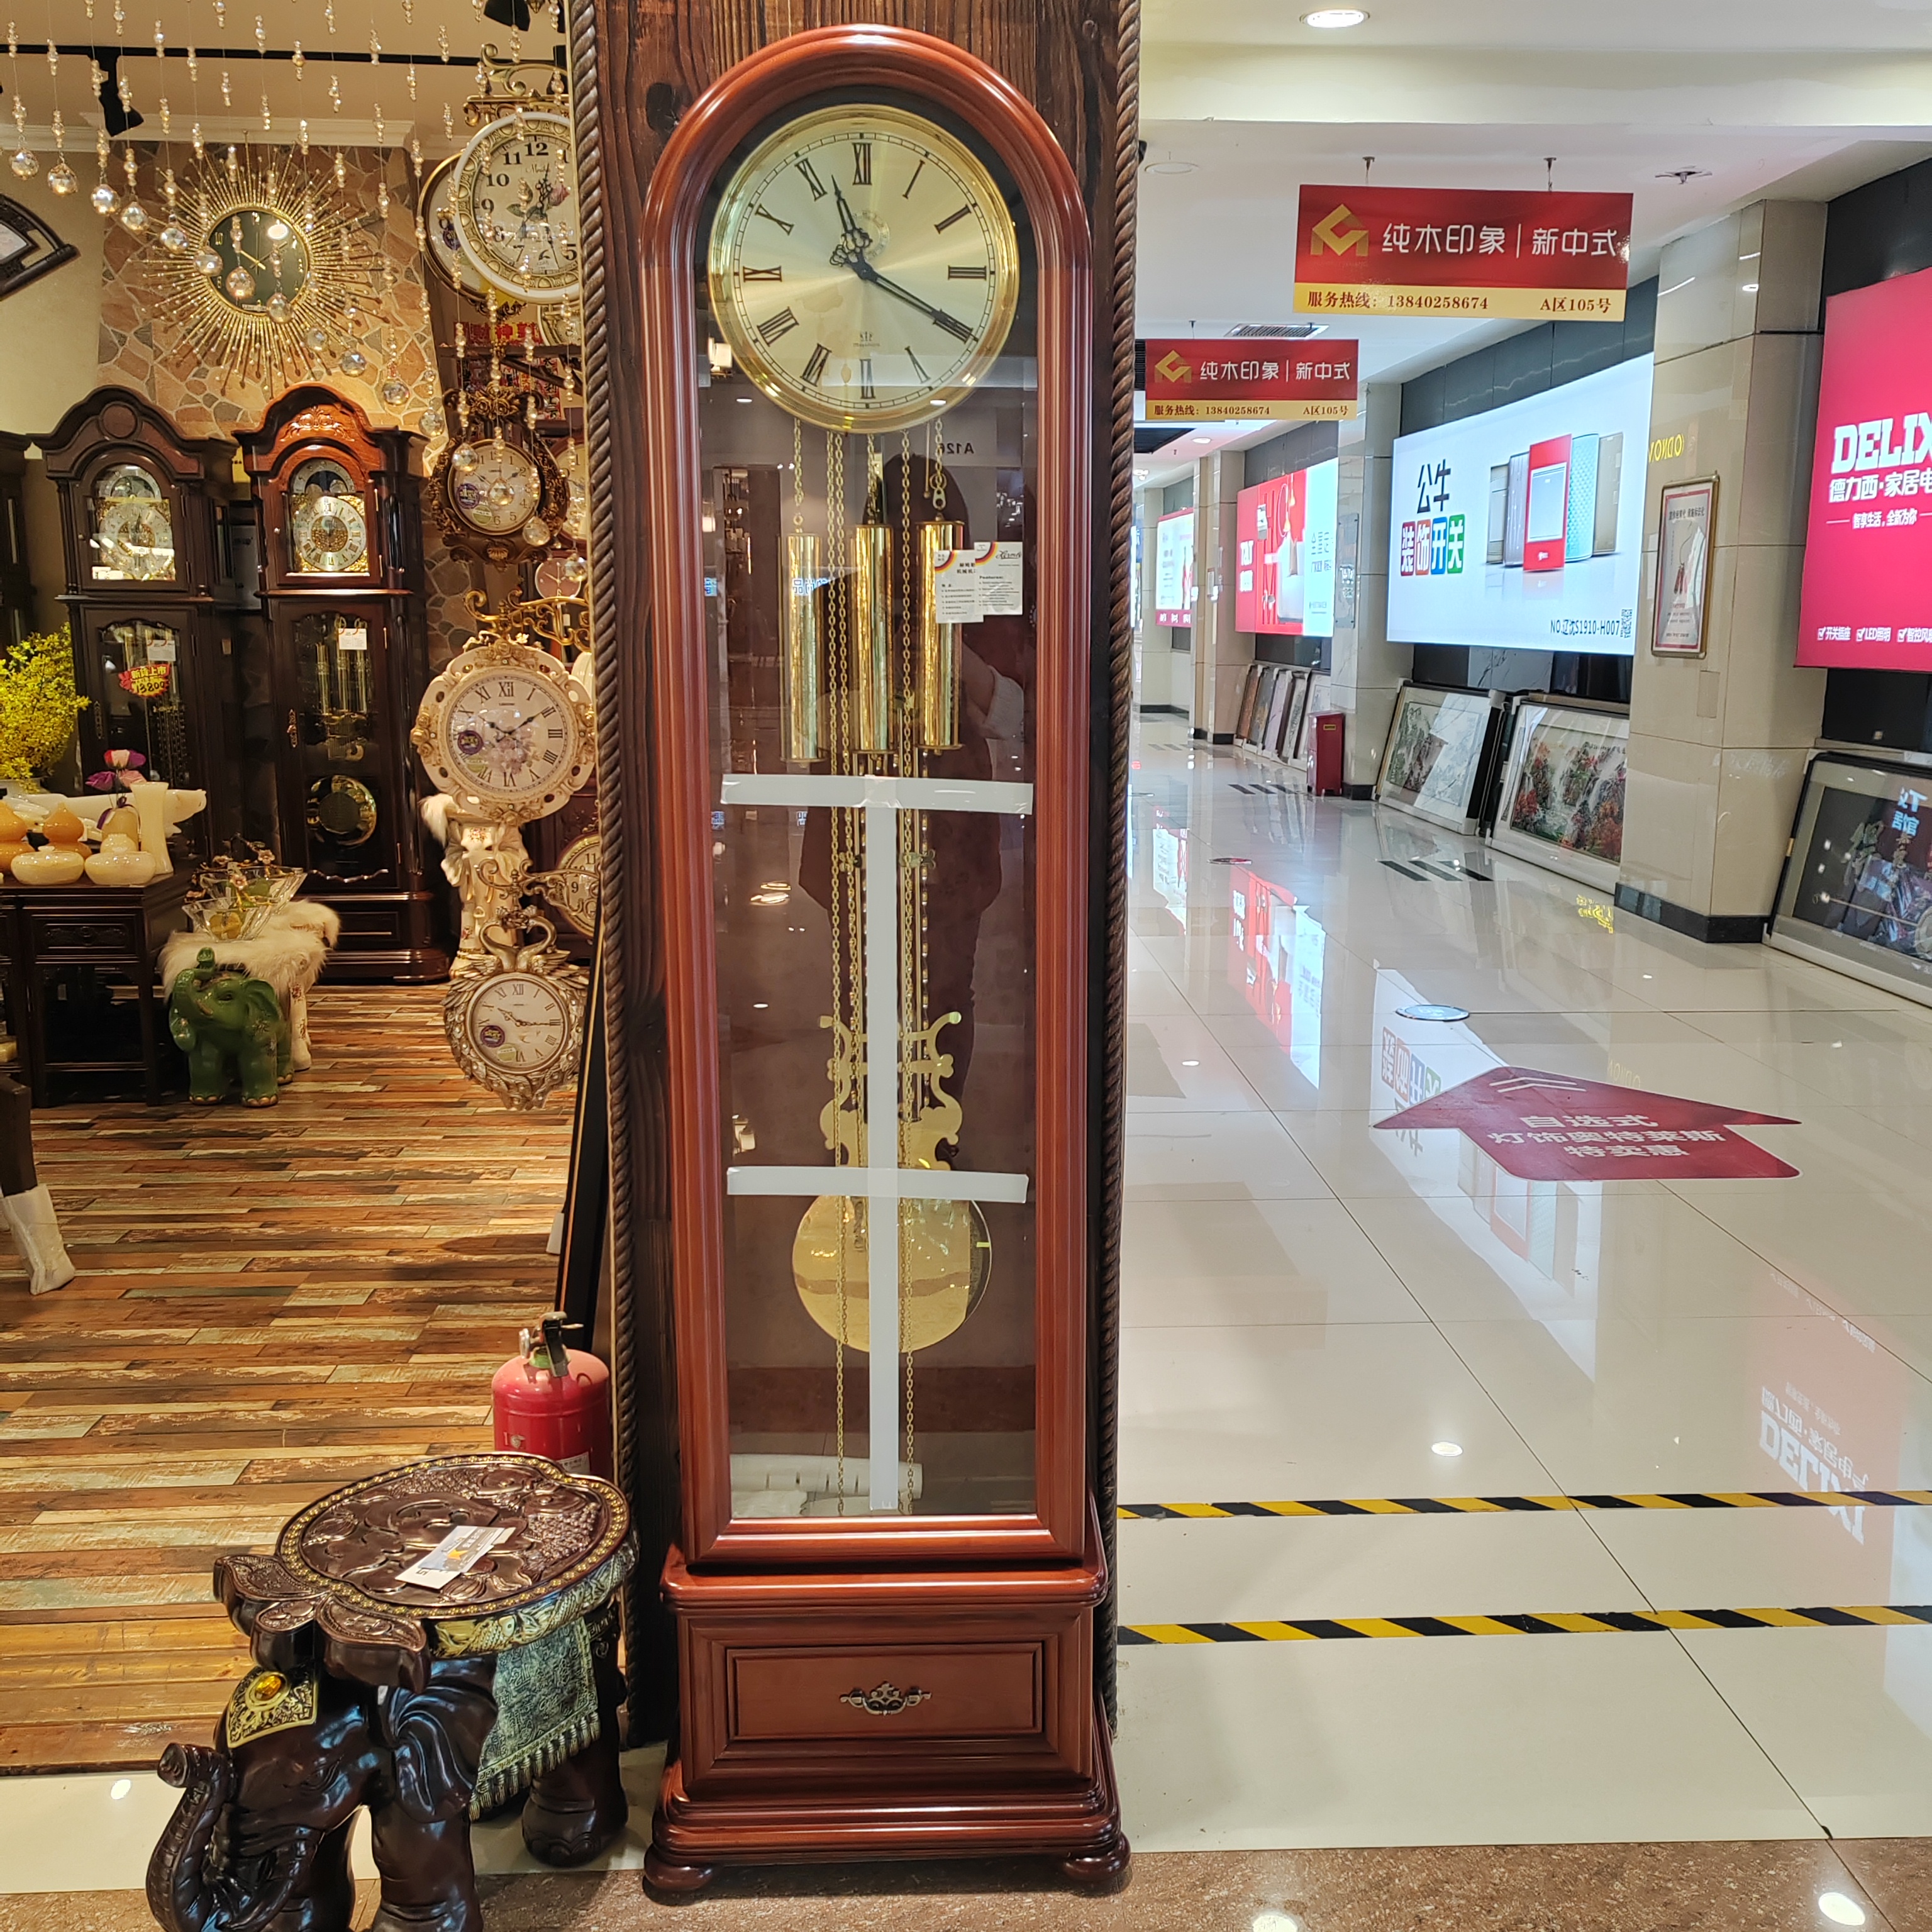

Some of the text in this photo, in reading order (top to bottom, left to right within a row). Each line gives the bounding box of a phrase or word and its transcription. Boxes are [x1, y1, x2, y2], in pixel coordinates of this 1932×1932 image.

[525, 142, 549, 156] 12
[1382, 223, 1618, 257] 纯木印象 新中式
[1387, 294, 1489, 310] 13840258674
[1540, 296, 1611, 313] A区105号
[1200, 361, 1351, 380] 纯木印象 新中式
[1206, 406, 1270, 415] 13840258674
[1303, 405, 1348, 416] A区105号
[1416, 459, 1451, 513] 公牛
[1401, 517, 1465, 574] 装饰开关
[1906, 628, 1932, 643] 智控风
[1519, 1114, 1659, 1128] 自选式
[1487, 1130, 1727, 1144] 灯饰奥特莱斯
